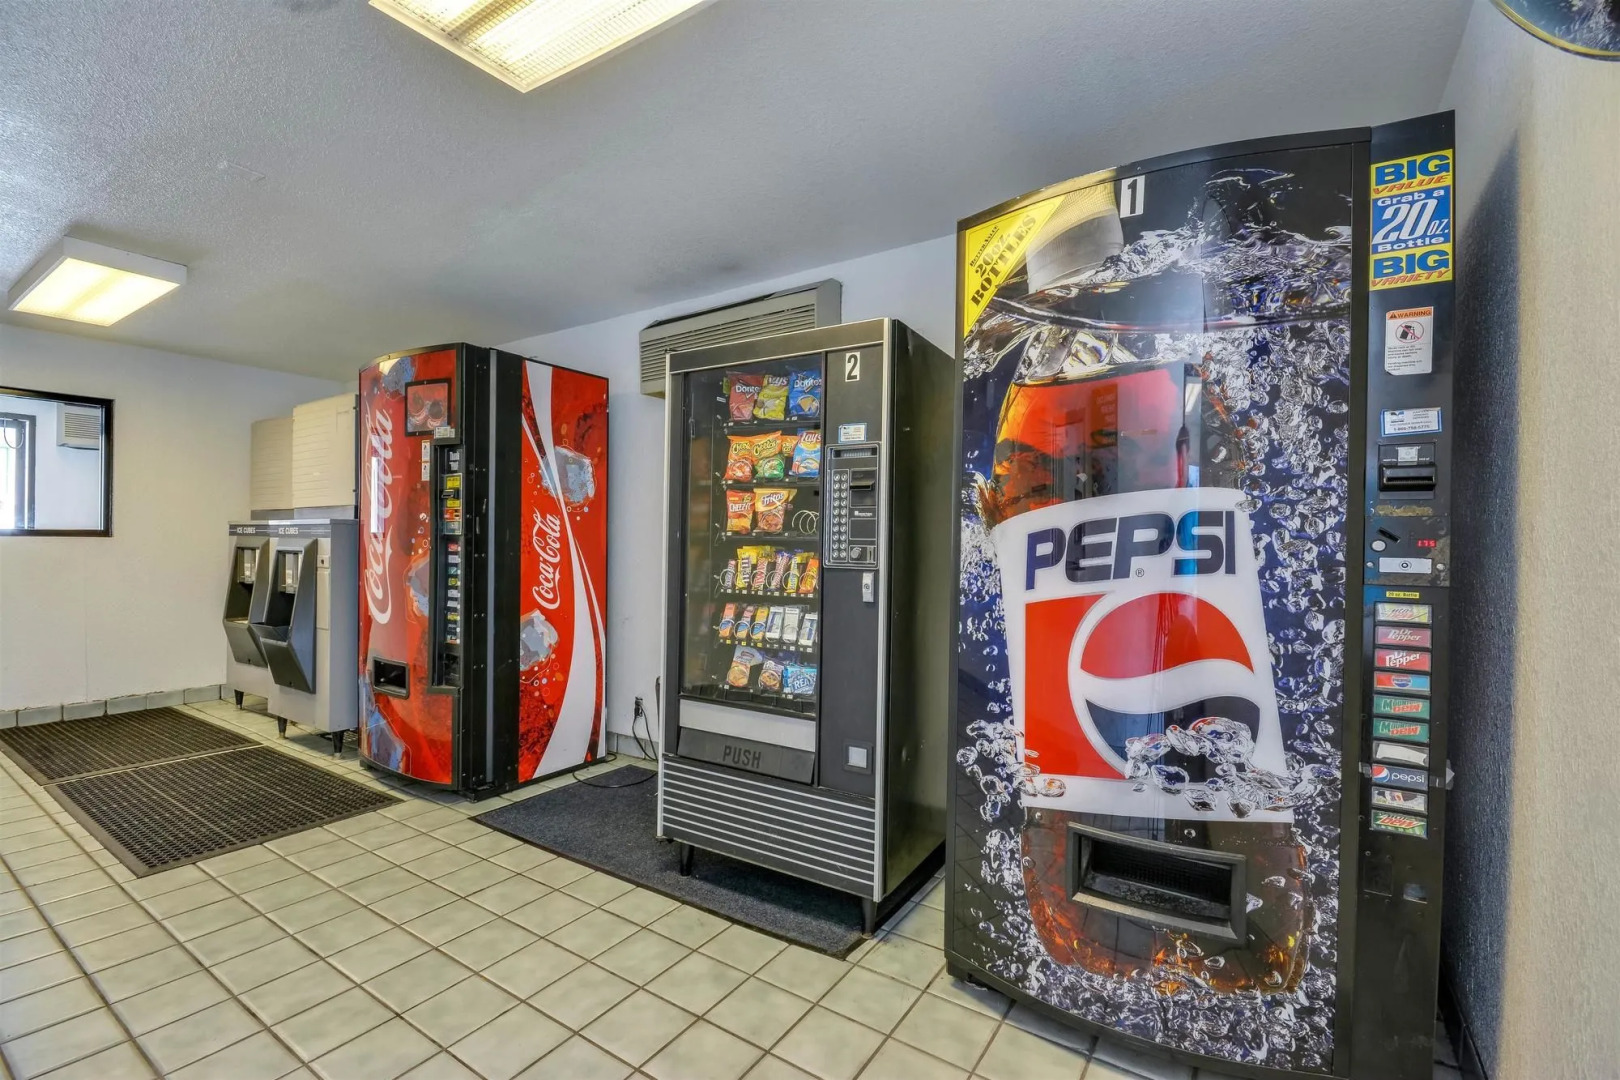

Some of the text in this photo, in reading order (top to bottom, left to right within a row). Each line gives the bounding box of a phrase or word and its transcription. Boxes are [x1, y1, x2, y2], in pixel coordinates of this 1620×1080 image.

[1375, 155, 1450, 187] BIG
[1373, 174, 1450, 194] VALUE
[1127, 178, 1138, 215] 1
[1377, 192, 1426, 206] Grab
[1372, 199, 1438, 245] 20
[1377, 237, 1445, 253] Bottle
[971, 214, 1037, 306] BOTTLES
[1374, 250, 1450, 279] BIG
[1371, 269, 1451, 287] VARIETY
[1397, 309, 1431, 318] WARNING
[846, 354, 858, 381] 2
[736, 383, 761, 394] Dorito
[762, 493, 785, 507] Fritos
[364, 401, 393, 625] CocaCola
[285, 527, 299, 535] CUBES
[532, 505, 561, 610] Coca-Cola
[1024, 509, 1237, 591] PEPSI
[1388, 630, 1422, 641] Pepper
[1385, 652, 1421, 667] Pepper
[722, 744, 762, 769] PUSH
[1391, 772, 1425, 783] pepsi
